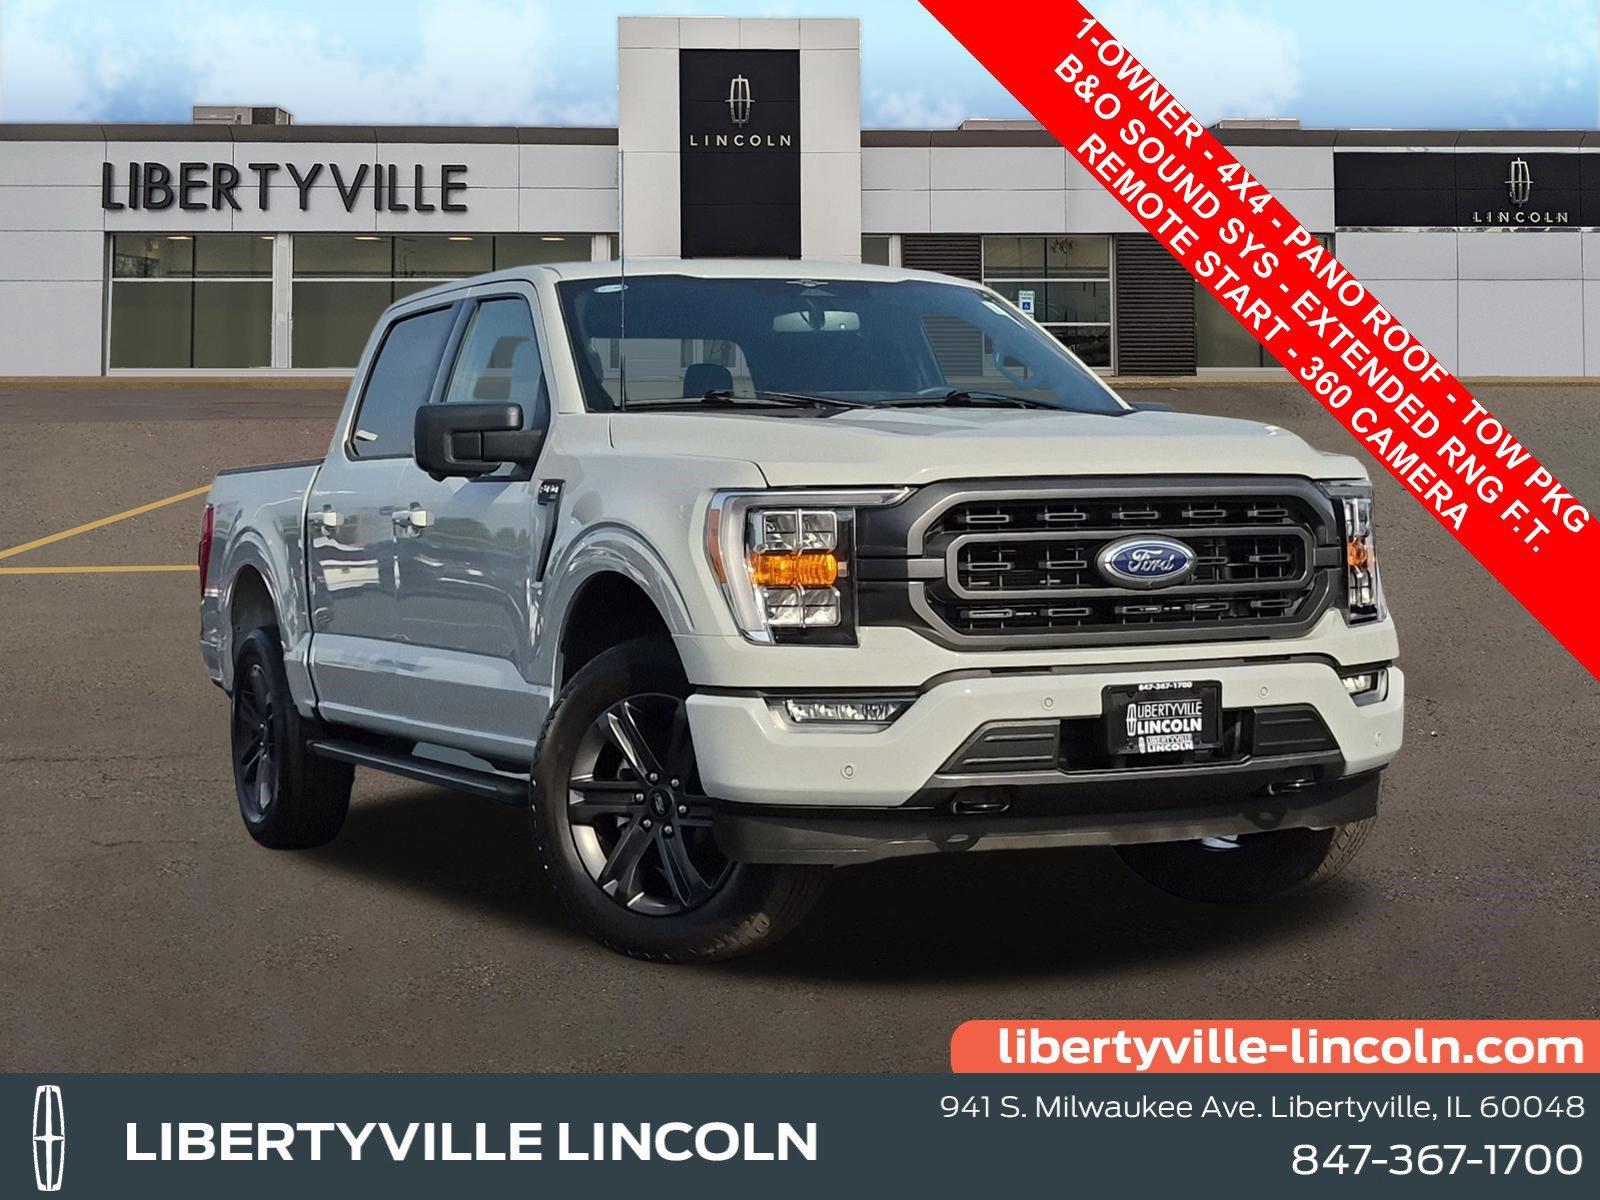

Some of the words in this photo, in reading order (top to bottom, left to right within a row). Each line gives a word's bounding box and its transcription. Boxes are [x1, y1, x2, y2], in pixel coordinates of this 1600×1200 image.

[690, 134, 791, 147] LINCOLN
[101, 161, 468, 213] LIBERTYVILLE
[1473, 211, 1569, 224] LINCOLN
[1128, 549, 1175, 573] Ford
[1137, 701, 1203, 718] LIBERTYVILLE
[1137, 718, 1202, 735] LINCOLN
[1147, 743, 1194, 753] LINCOLN
